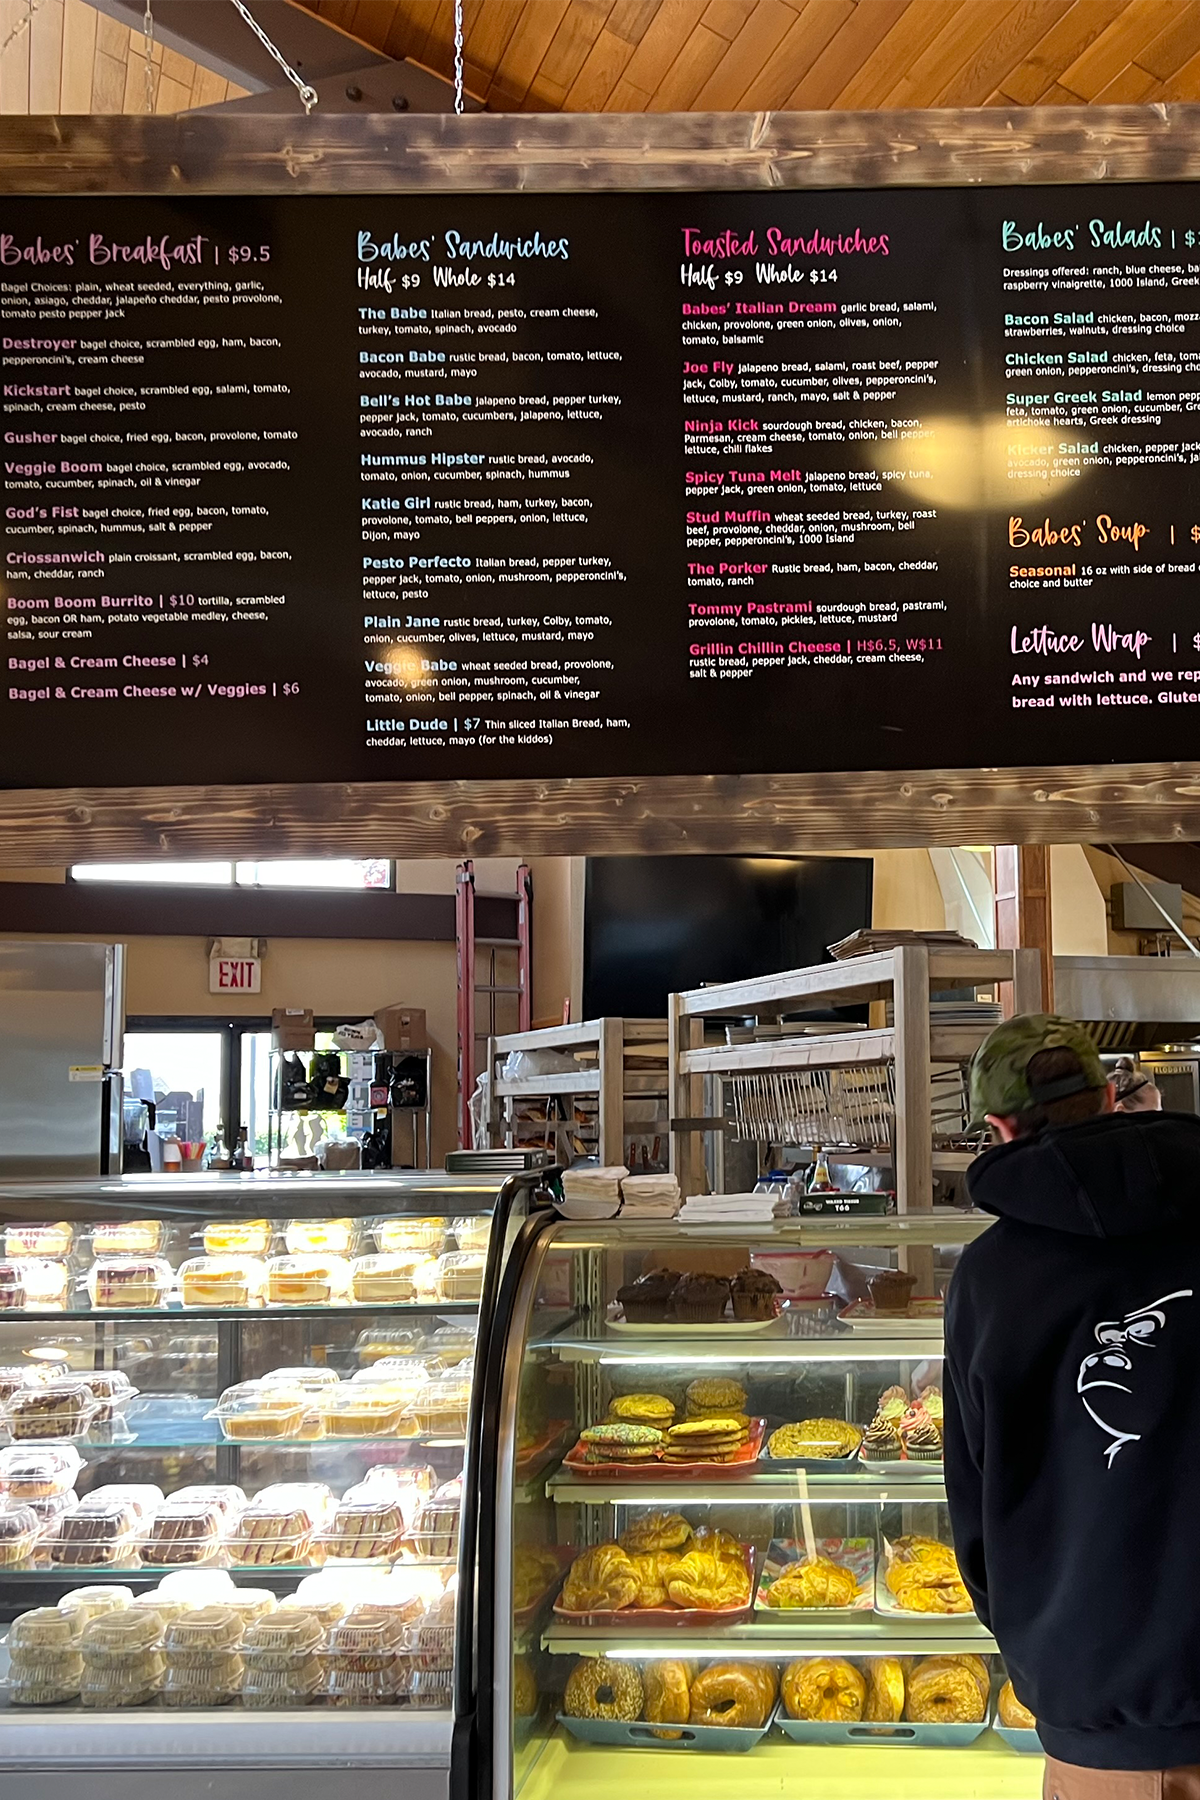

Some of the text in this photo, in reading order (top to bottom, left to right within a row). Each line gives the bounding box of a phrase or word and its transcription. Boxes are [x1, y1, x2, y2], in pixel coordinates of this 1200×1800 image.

[1088, 220, 1162, 249] Salads
[444, 230, 569, 260] Sandwiches
[681, 227, 889, 259] Toasted Sandwiches
[89, 233, 209, 271] Breakfast
[228, 245, 270, 265] $9.5
[357, 265, 516, 294] Half $9 Whole $14
[680, 262, 838, 291] Half $9 Whole $14
[0, 280, 265, 294] Bagel Choices: plain, wheat seeded, everything, garlic,
[358, 306, 599, 320] The Babe Italian bread, pesto, cream cheese,
[735, 301, 784, 315] Italian
[788, 301, 837, 313] Dream
[1004, 312, 1094, 325] Bacon Salad
[1004, 322, 1185, 337] strawberries, walnuts, dressing choice
[2, 337, 281, 352] Destroyer bagel choice, scrambled egg, ham, bacon,
[77, 356, 109, 364] cream
[110, 354, 145, 364] cheese
[359, 350, 446, 363] Bacon Babe
[1005, 350, 1108, 365] Chicken Salad
[682, 360, 734, 376] Joe Fly
[3, 384, 71, 396] Kickstart
[1006, 389, 1142, 406] Super Greek Salad
[404, 394, 431, 407] Hot
[435, 393, 472, 406] Babe
[684, 418, 759, 434] Ninja Kick
[4, 431, 58, 444] Gusher
[1007, 442, 1099, 456] Kicker Salad
[361, 452, 486, 467] Hummus Hipster
[4, 461, 103, 476] Veggie Boom
[685, 469, 802, 485] Spicy Tuna Melt
[361, 496, 431, 510] Katie Girl
[52, 506, 79, 518] Fist
[686, 510, 771, 523] Stud Muffin
[1096, 515, 1150, 551] Soup
[363, 555, 472, 569] Pesto Perfecto
[687, 560, 939, 577] The Porker Rustic bread, ham, bacon, cheddar,
[1009, 562, 1196, 578] Seasonal 16 oz with side of bread
[687, 575, 754, 588] tomato, ranch
[1009, 577, 1094, 589] choice and butter
[7, 593, 195, 609] Boom Boom Burrito $10
[688, 600, 813, 618] Tommy Pastrami
[364, 615, 440, 628] Plain Jane
[689, 638, 942, 656] Grillin Chillin Cheese H$6.5, W$11
[1010, 623, 1153, 660] Lettuce Wrap
[8, 654, 209, 672] Bagel & Cream Cheese $4
[364, 658, 458, 674] Veggie Babe
[1011, 673, 1040, 688] Any
[1044, 670, 1115, 685] sandwich
[1118, 669, 1147, 683] and
[1150, 671, 1174, 682] we
[8, 682, 300, 702] Bagel & Cream Cheese w/ Veggies $6
[1012, 694, 1055, 708] bread
[1058, 693, 1092, 707] with
[1096, 693, 1153, 706] lettuce.
[366, 717, 481, 732] Little Dude $7
[219, 961, 255, 988] EXIT
